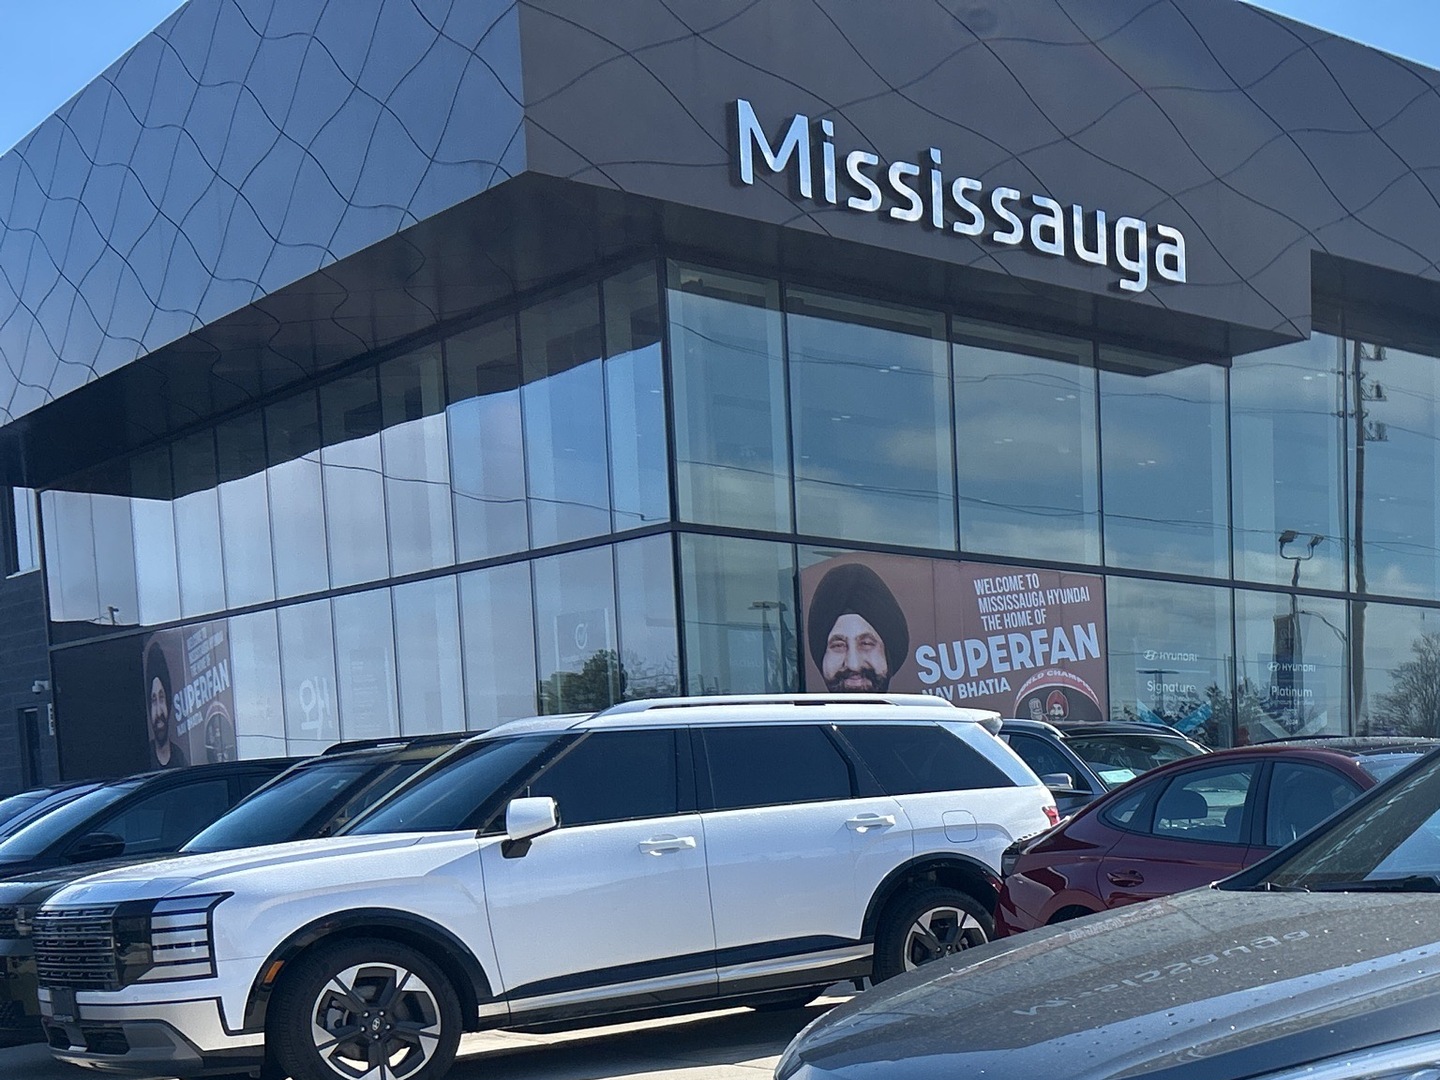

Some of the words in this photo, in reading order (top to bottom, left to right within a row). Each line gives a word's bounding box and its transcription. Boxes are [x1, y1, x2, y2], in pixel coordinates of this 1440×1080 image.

[736, 98, 1187, 292] Mississauga
[974, 574, 1025, 596] WELCOME
[1025, 572, 1040, 590] TO
[978, 590, 1046, 614] MISSISSAUGA
[1046, 586, 1090, 606] HYUNDAI
[981, 614, 1003, 632] THE
[1003, 610, 1034, 629] HOME
[1034, 608, 1047, 625] OF
[915, 622, 1101, 685] SUPERFAN
[1282, 663, 1316, 672] HYUNDAI
[173, 658, 230, 721] SUPERFAN
[957, 676, 1012, 700] BHATIA
[1147, 680, 1197, 693] Signature
[1271, 685, 1313, 698] Platinum
